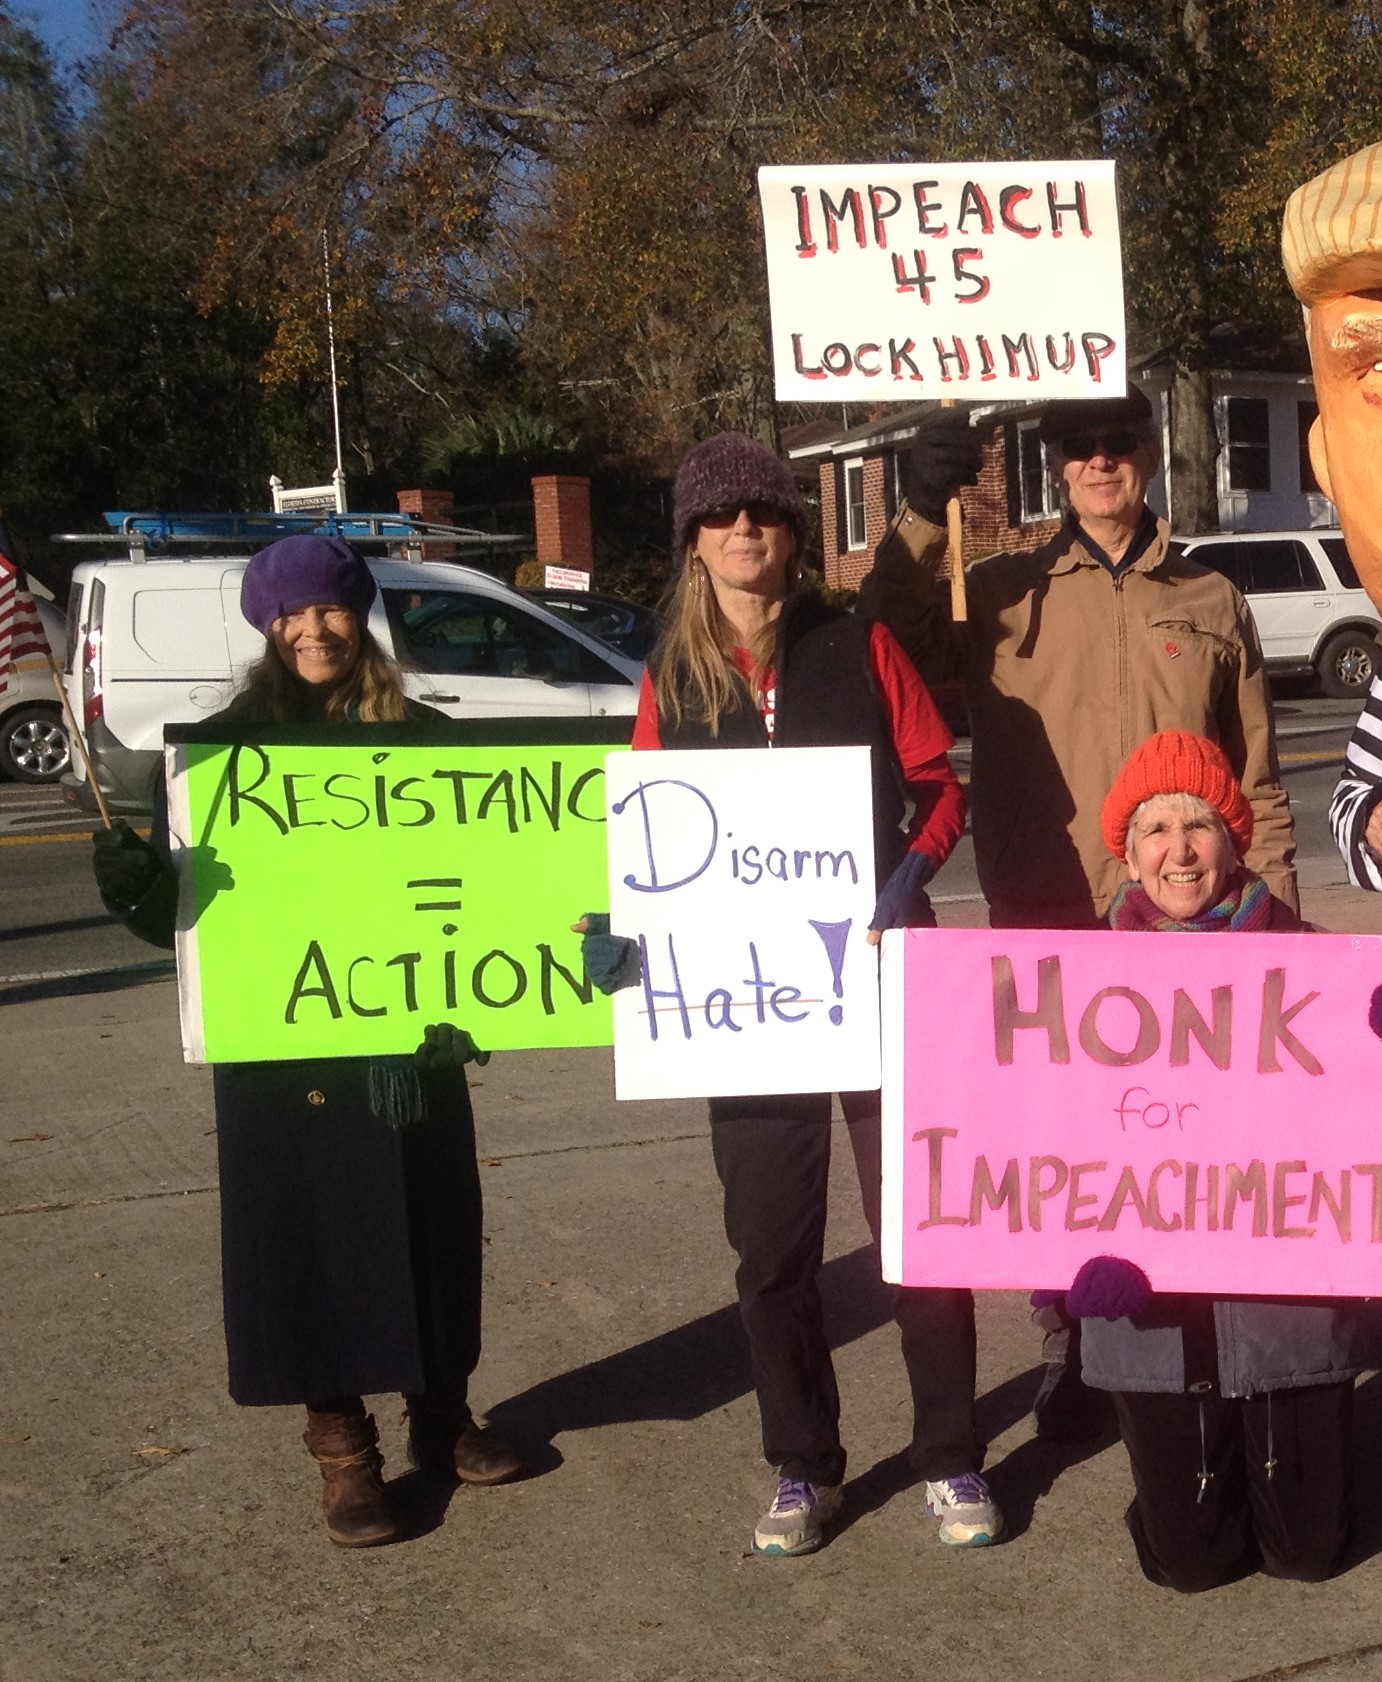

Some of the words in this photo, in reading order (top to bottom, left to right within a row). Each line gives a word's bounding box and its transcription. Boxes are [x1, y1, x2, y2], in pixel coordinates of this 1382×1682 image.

[790, 180, 1093, 258] IMPEACH
[891, 247, 991, 306] 45
[791, 333, 924, 381] LOCK
[229, 744, 608, 835] RESISTANC
[612, 779, 858, 893] Disarm
[637, 918, 853, 1042] Hate!
[991, 955, 1325, 1076] HONK
[1113, 1086, 1200, 1131] for
